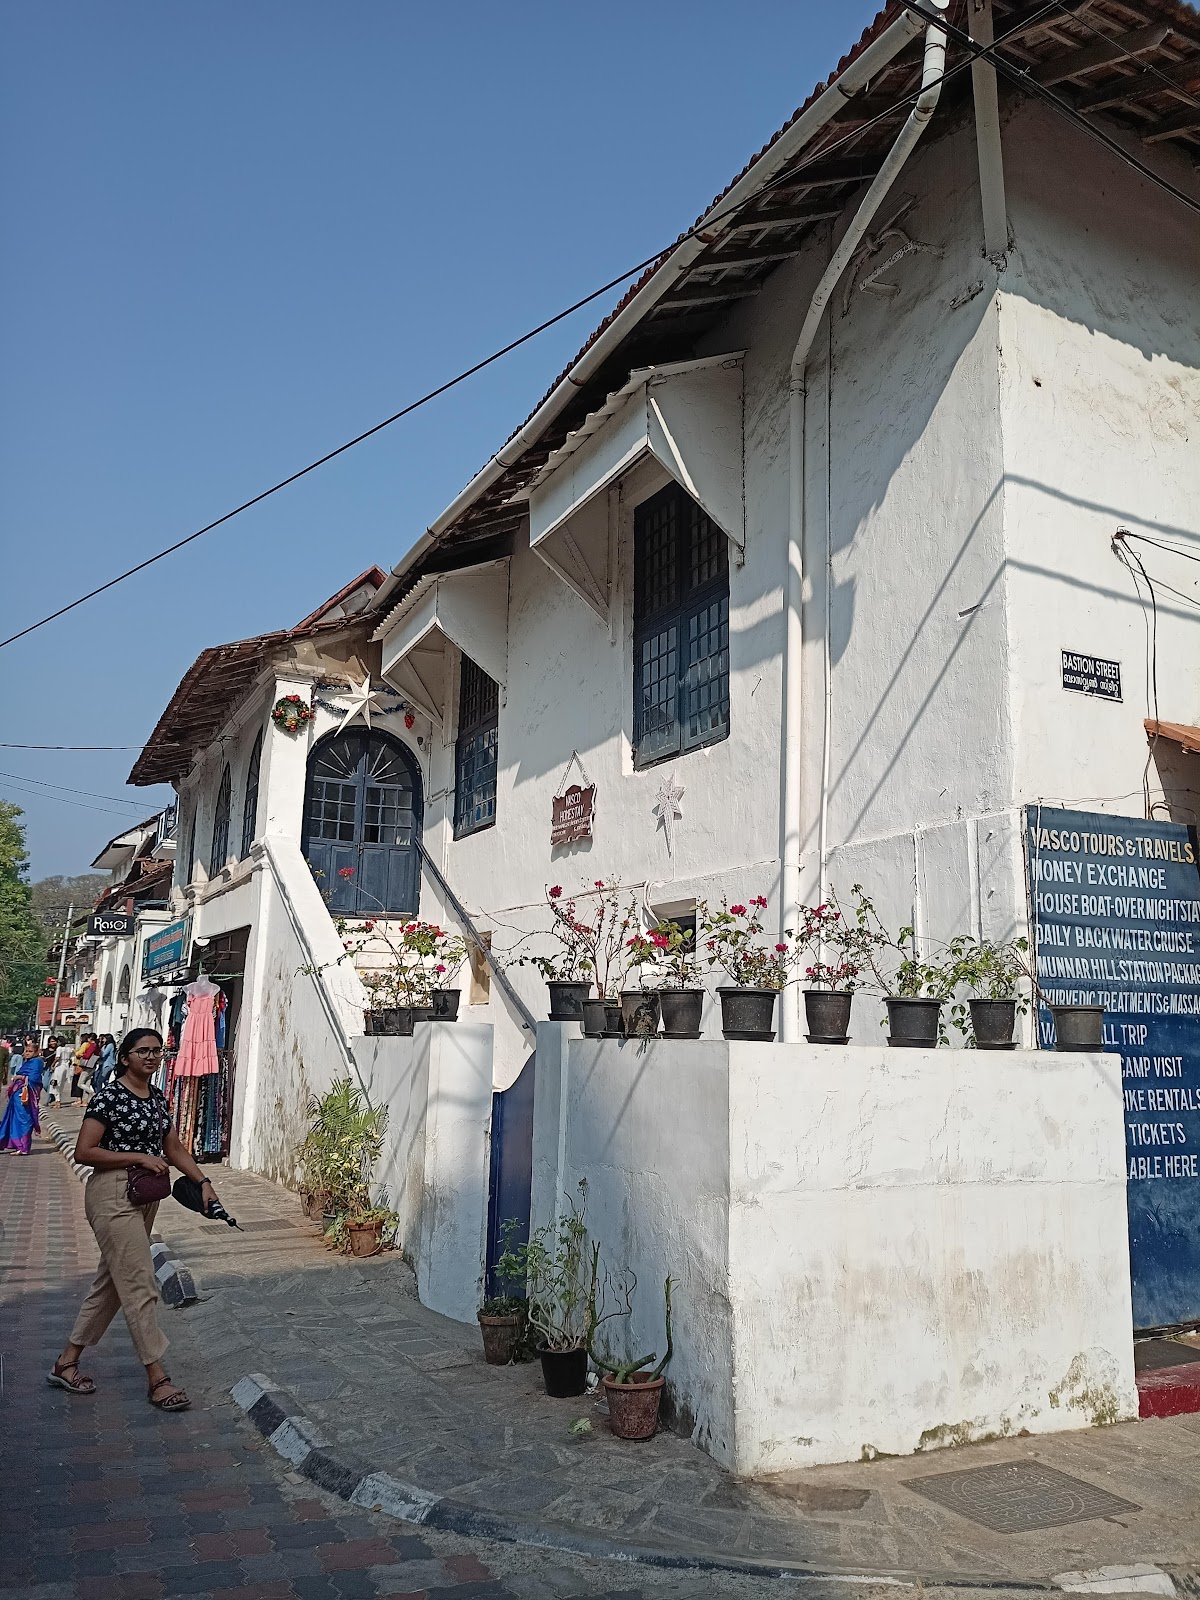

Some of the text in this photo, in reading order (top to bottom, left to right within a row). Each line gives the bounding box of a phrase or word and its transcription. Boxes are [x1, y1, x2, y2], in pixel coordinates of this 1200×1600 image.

[1062, 653, 1118, 680] BASTION STREET
[566, 792, 581, 807] VASCO
[560, 804, 584, 822] HOMESTAY
[1030, 826, 1080, 852] VASCO
[1081, 832, 1124, 856] TOURS
[1126, 840, 1136, 856] &
[1031, 858, 1167, 890] MONEY EXCHANGE
[1036, 892, 1080, 915] HOUSE
[94, 916, 128, 932] Rasoi
[1036, 923, 1195, 954] DAILY BACKWATER CRUISE
[1037, 956, 1092, 979] MUNNAR
[1090, 958, 1120, 981] HILL
[1119, 960, 1166, 983] STATION
[1097, 990, 1163, 1014] TREATMENTS
[1163, 996, 1170, 1014] &
[1170, 994, 1200, 1015] MASSA
[1120, 1024, 1148, 1046] TRIP
[1153, 1056, 1182, 1078] VISIT
[1123, 1089, 1147, 1112] IKE
[1128, 1122, 1187, 1146] TICKETS
[1127, 1154, 1198, 1180] ABLE HERE
